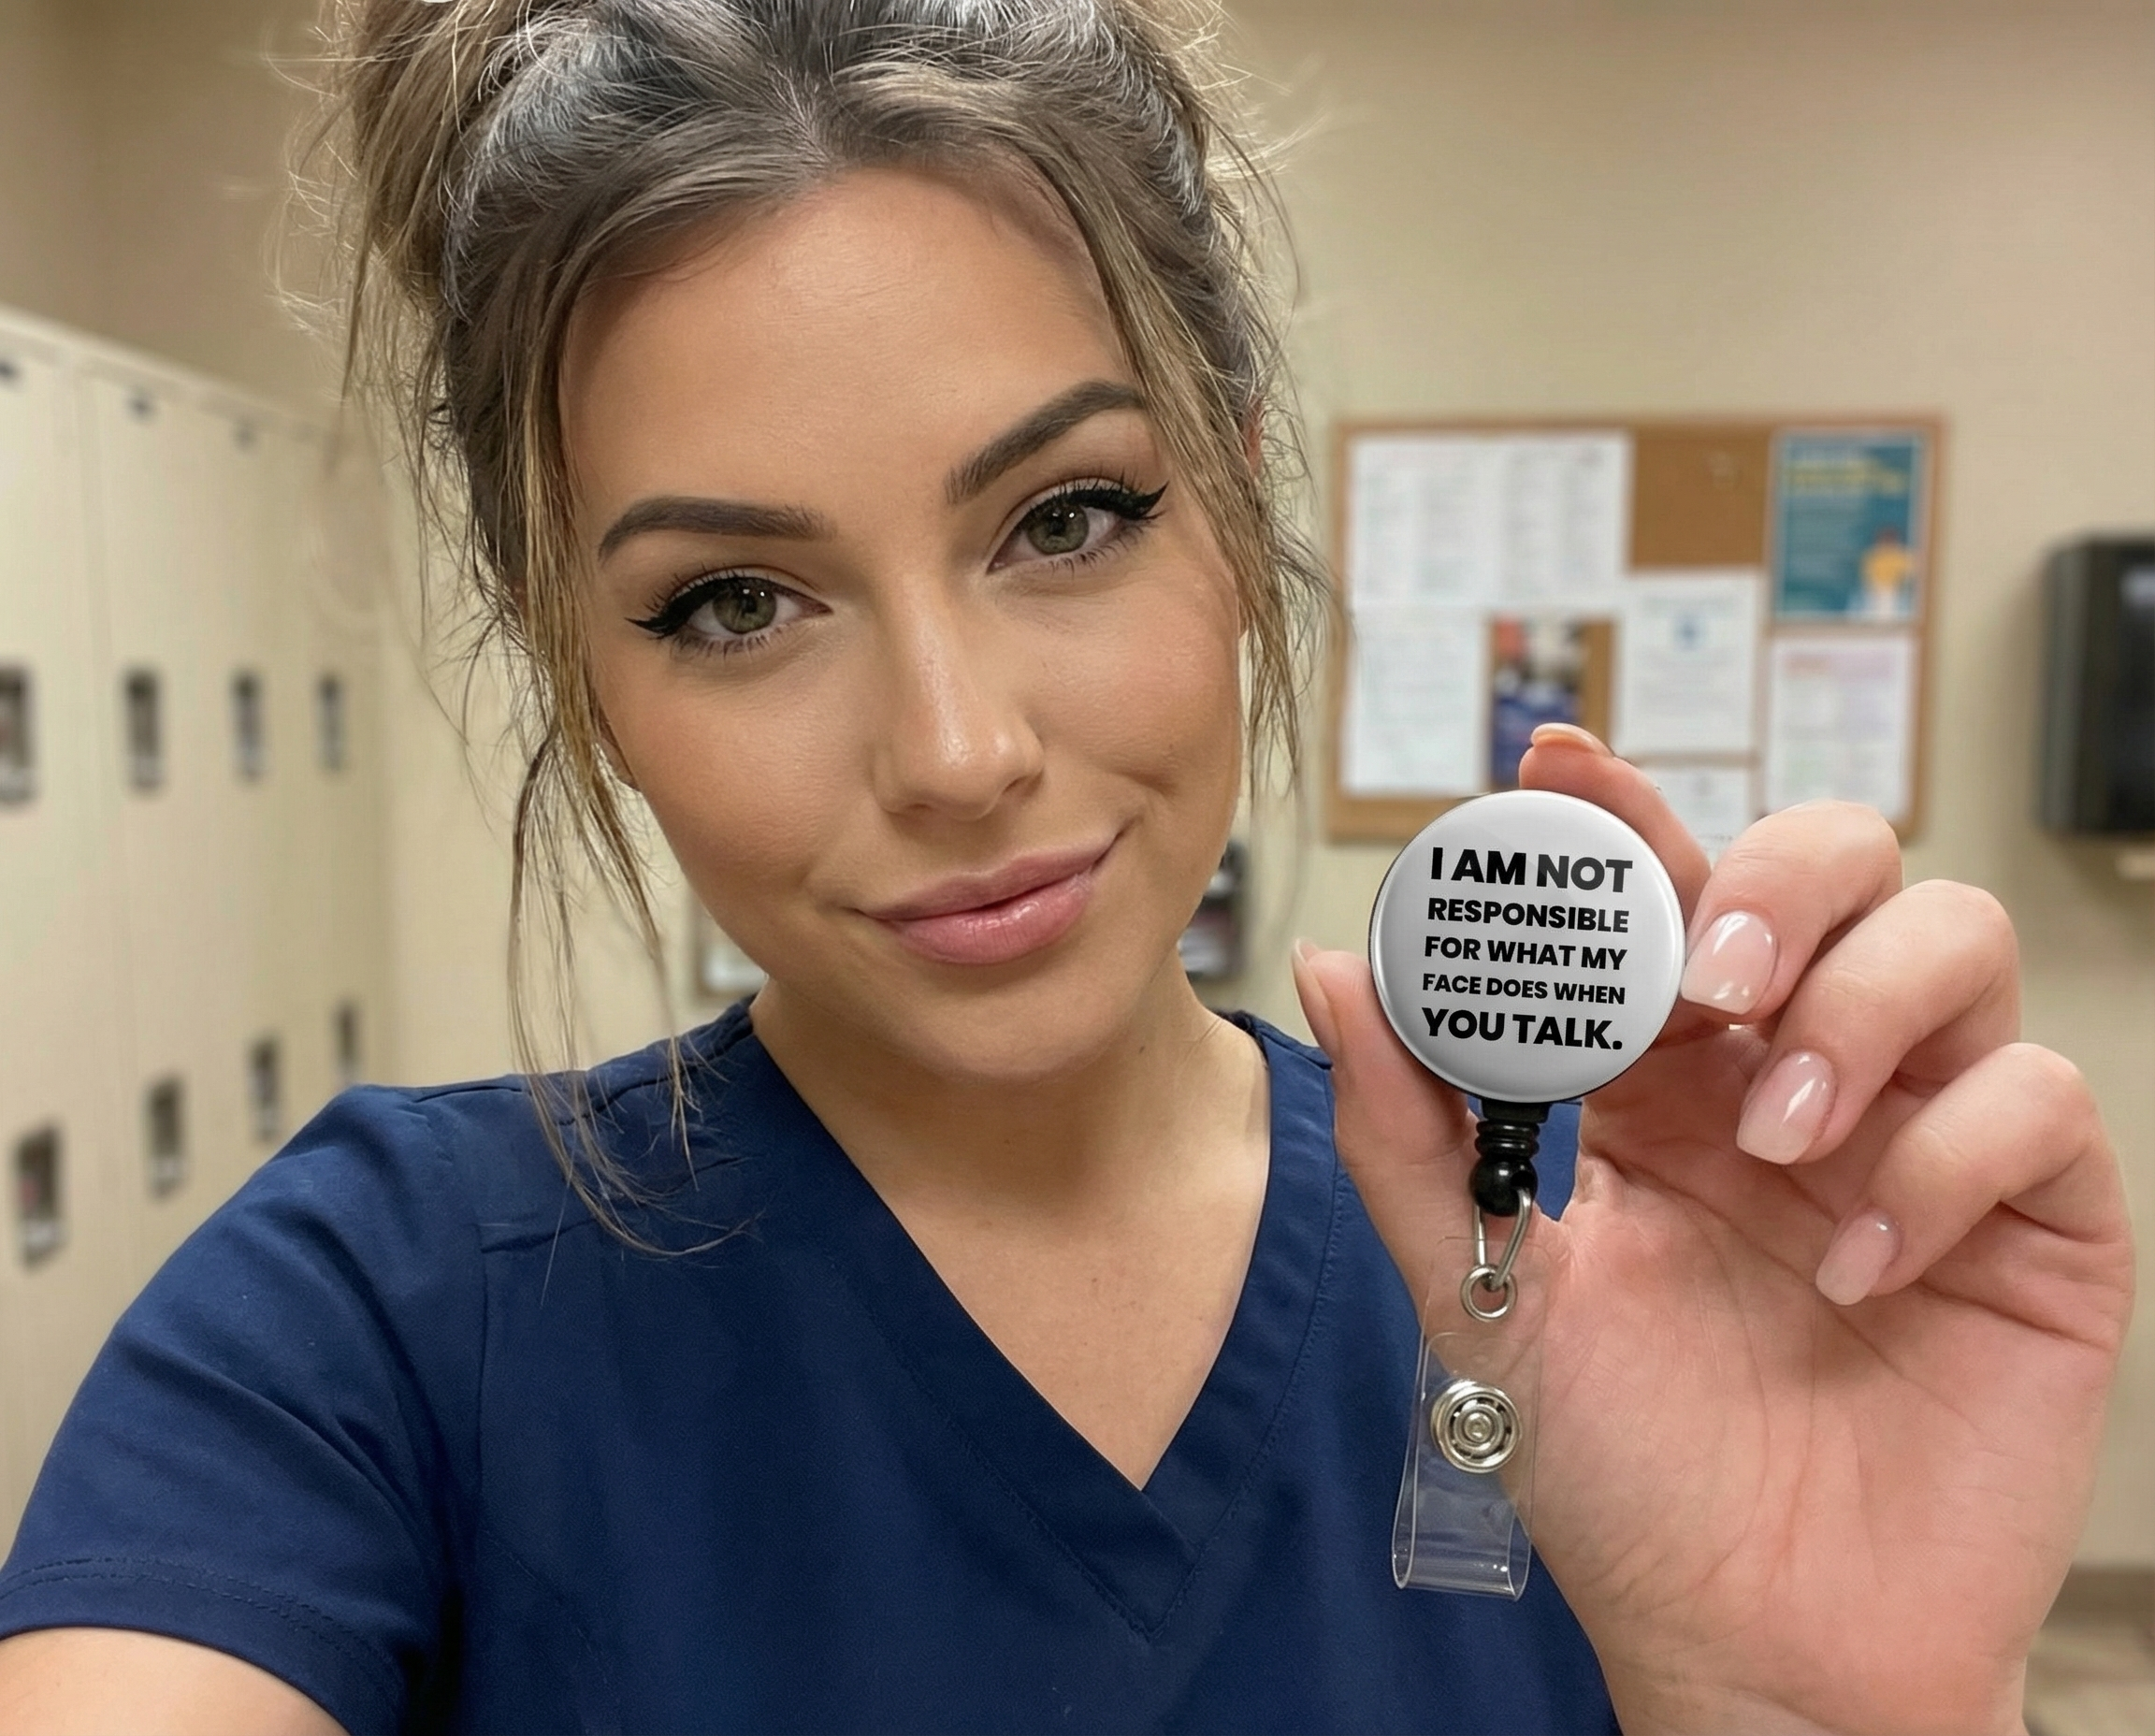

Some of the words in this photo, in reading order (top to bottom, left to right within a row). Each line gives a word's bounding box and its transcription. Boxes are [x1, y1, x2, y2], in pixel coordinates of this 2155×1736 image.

[1431, 847, 1443, 879] I
[1451, 849, 1526, 885] AM
[1537, 854, 1632, 892] NOT
[1428, 898, 1628, 933] RESPONSIBLE
[1425, 936, 1481, 960] FOR
[1487, 940, 1576, 966] WHAT
[1582, 947, 1627, 970] MY
[1423, 974, 1482, 994] FACE
[1486, 977, 1548, 999] DOES
[1554, 982, 1625, 1005] WHEN
[1422, 1007, 1505, 1041] YOU
[1512, 1014, 1622, 1049] TALK.
